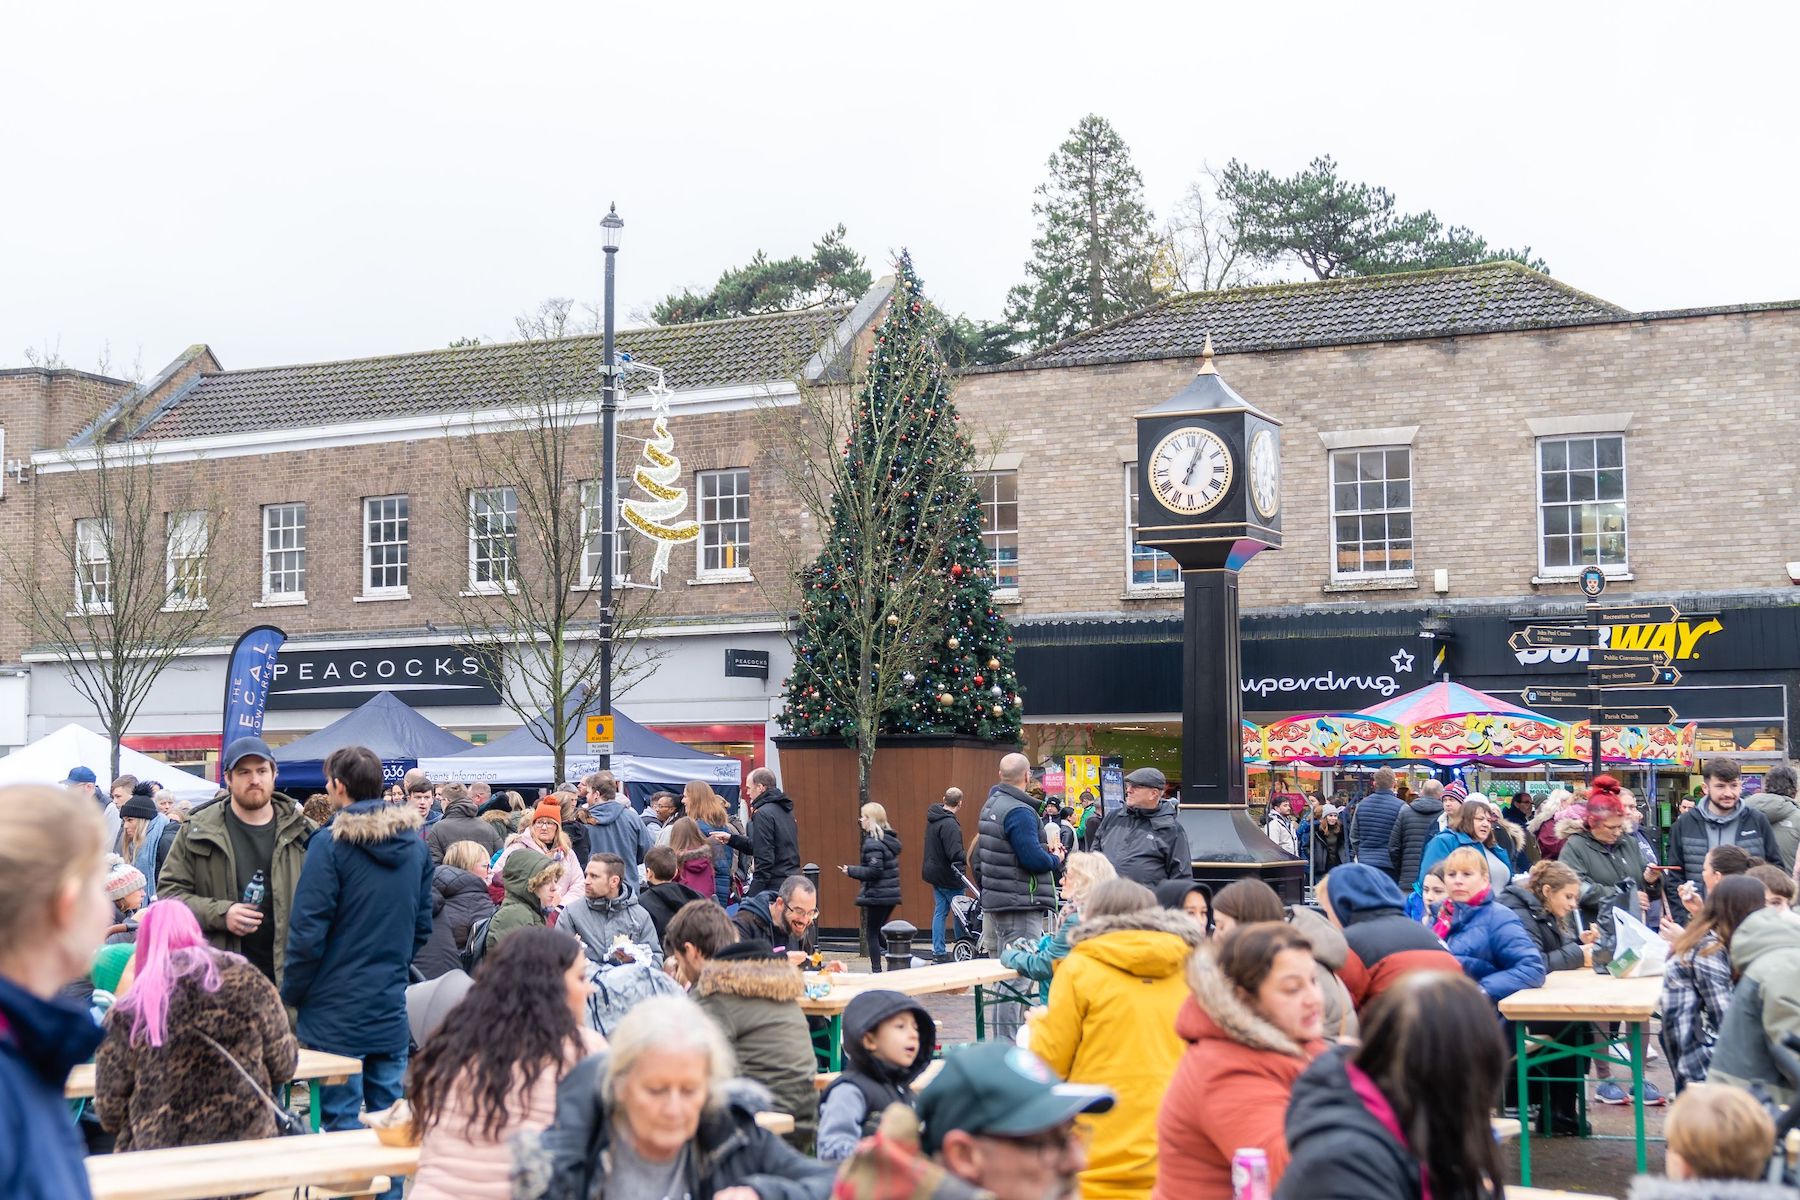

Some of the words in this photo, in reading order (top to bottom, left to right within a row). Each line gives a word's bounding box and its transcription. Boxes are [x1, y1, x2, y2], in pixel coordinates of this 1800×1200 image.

[272, 656, 480, 680] PEACOCKS
[232, 678, 242, 704] THE
[254, 654, 276, 736] TOWMARKET
[1240, 670, 1400, 697] uperdrug
[424, 771, 449, 780] Events
[452, 770, 497, 780] Information
